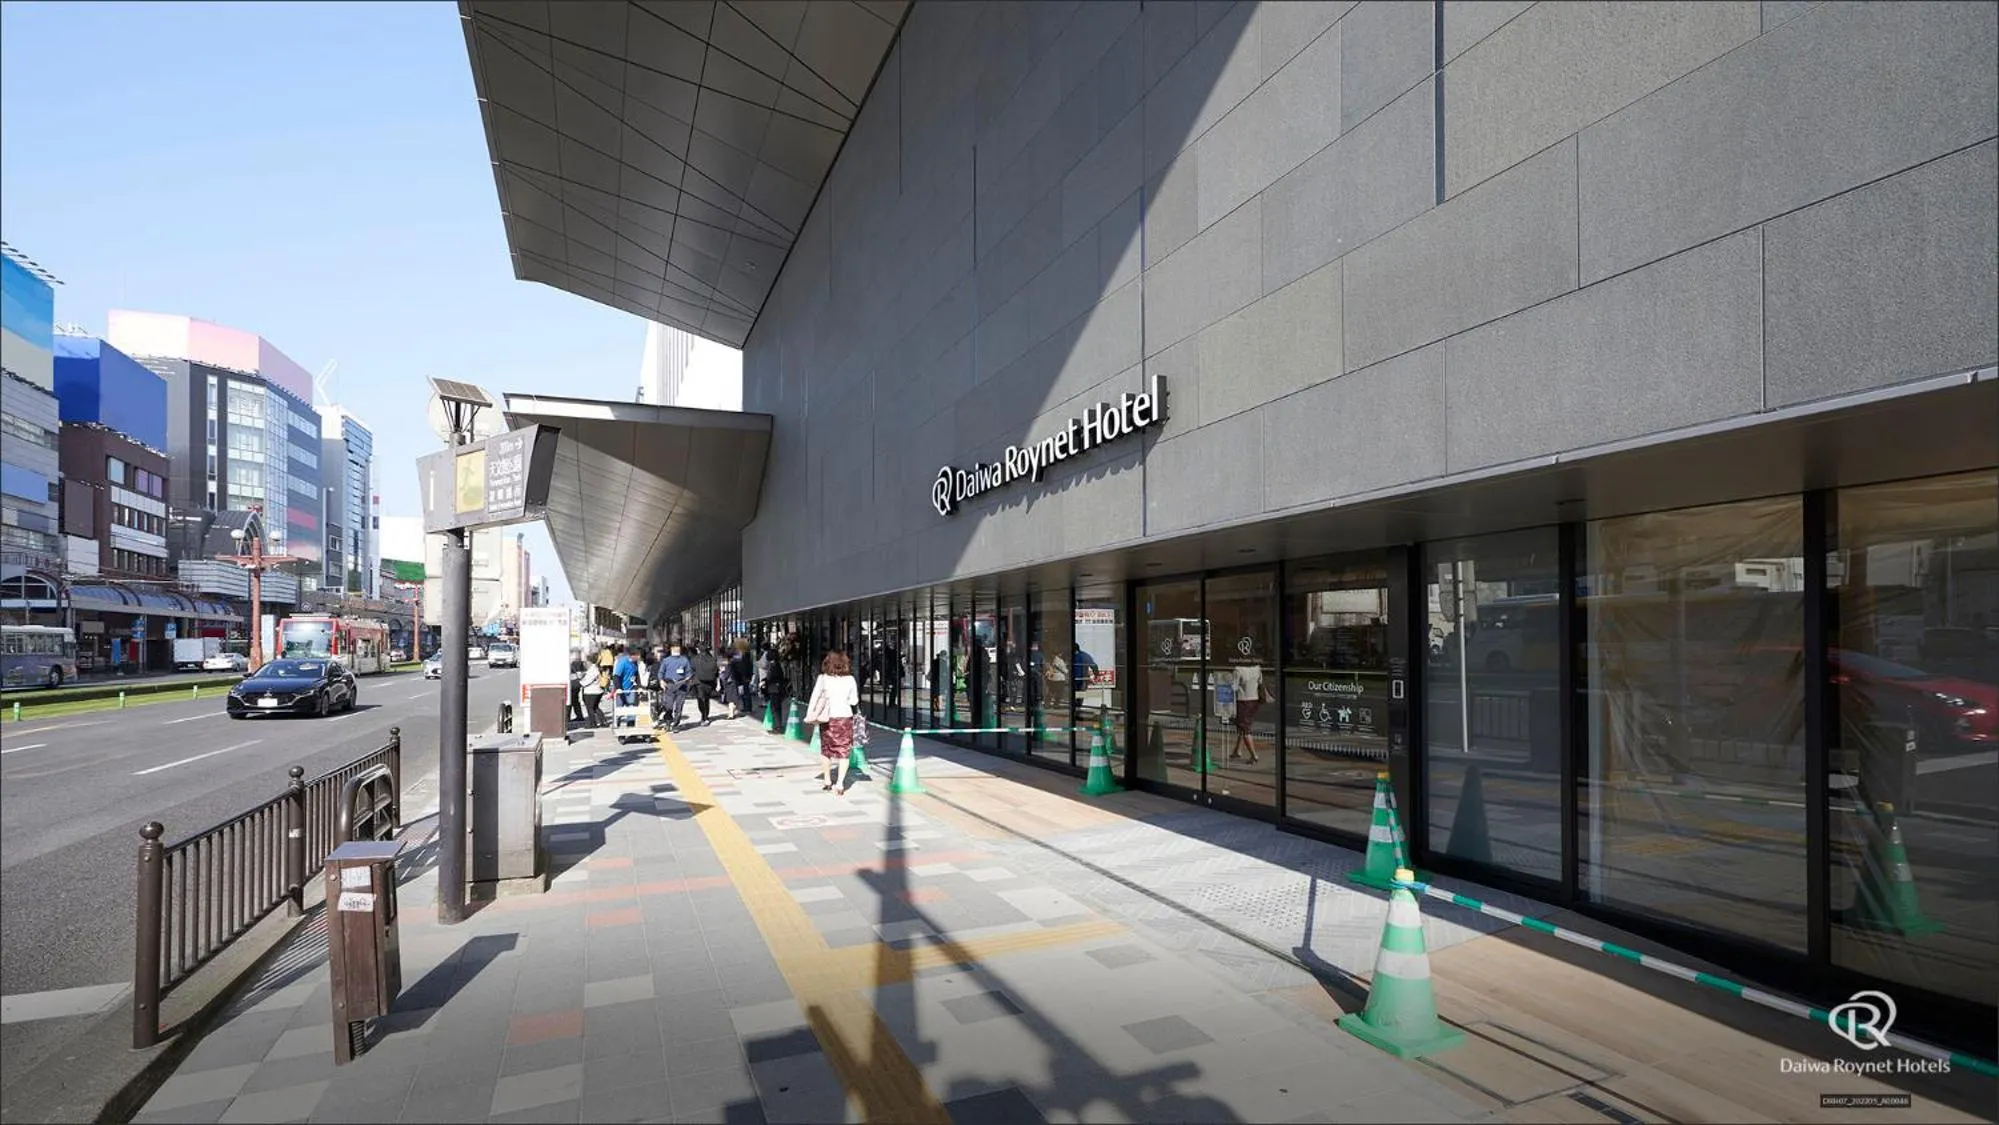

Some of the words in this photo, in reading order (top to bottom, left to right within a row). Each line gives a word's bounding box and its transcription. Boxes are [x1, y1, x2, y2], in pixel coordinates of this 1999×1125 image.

[956, 463, 1002, 502] Daiwa
[1005, 418, 1079, 483] Roynet
[1083, 374, 1160, 451] Hotel
[1308, 681, 1321, 690] Our
[1322, 681, 1364, 695] Citizenship
